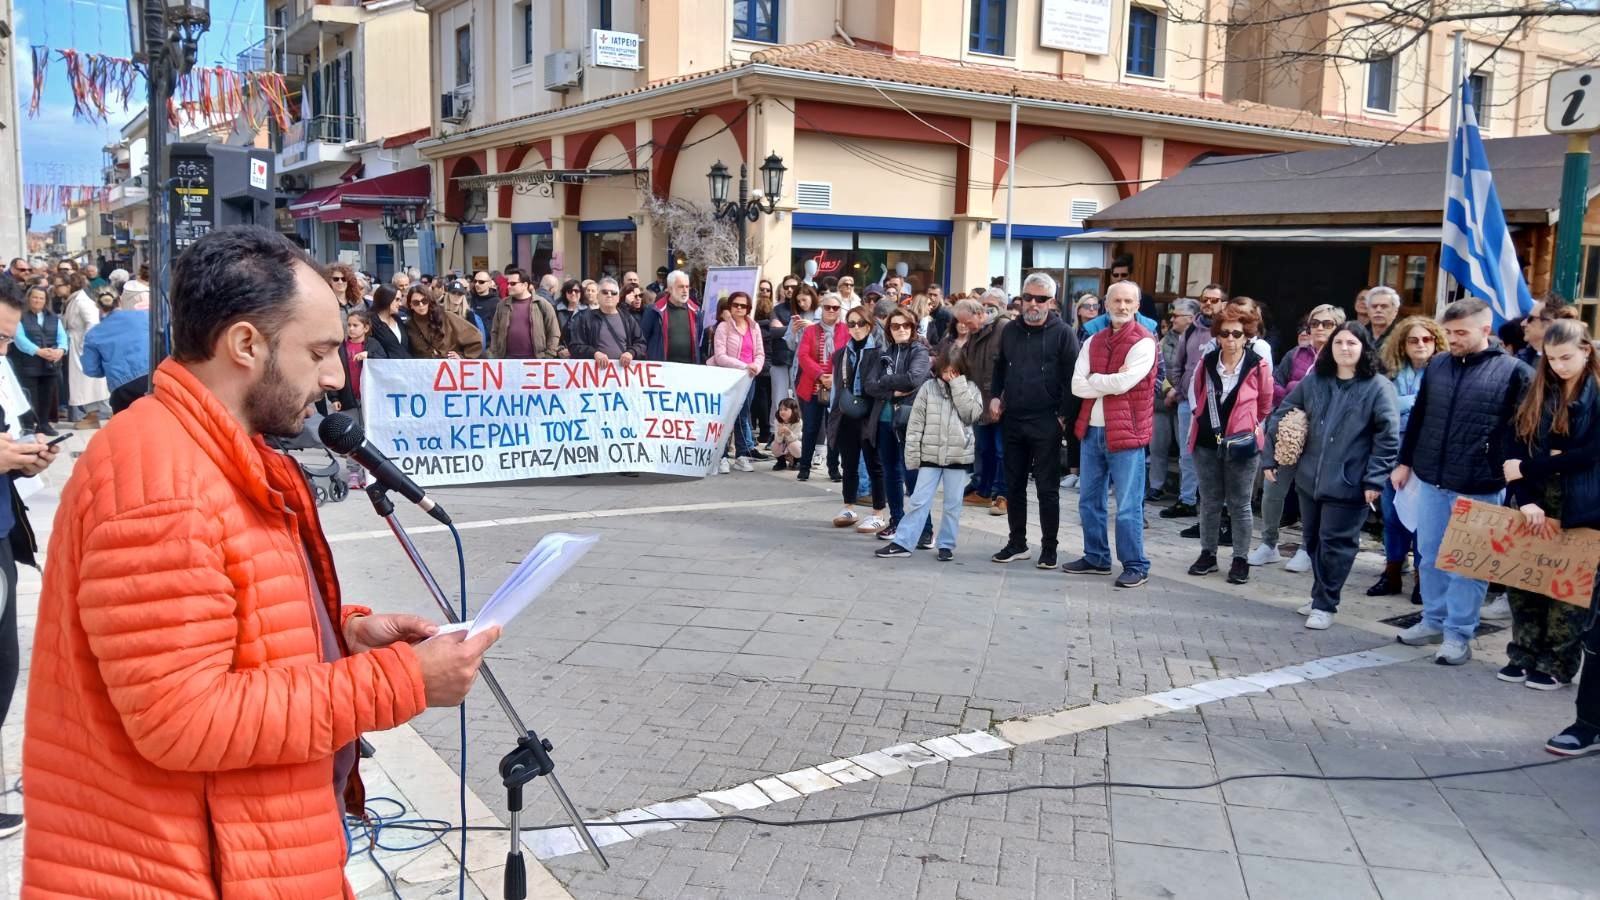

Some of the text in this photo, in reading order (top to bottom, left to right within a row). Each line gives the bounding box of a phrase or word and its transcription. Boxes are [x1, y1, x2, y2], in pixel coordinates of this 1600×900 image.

[611, 36, 637, 47] ΙΑΤΡΕΙΟ
[433, 360, 665, 391] ΔΕΝ ΞΕΧΝΑΜΕ
[387, 390, 721, 419] ΤΟ ΕΓΚΛΗΜΑ ΣΤΑ ΤΕΜΠΗ
[392, 417, 725, 452] ή τα ΚΕΡΔΗ ΤΟΥΣ ή οι ΖΩΕΣ ΜΑ
[387, 453, 484, 476] ΩΜΑΤΕΙΟ
[500, 443, 599, 471] ΕΡΓΑΖ/ΝΩΝ
[608, 442, 654, 464] Ο.Τ.Α.
